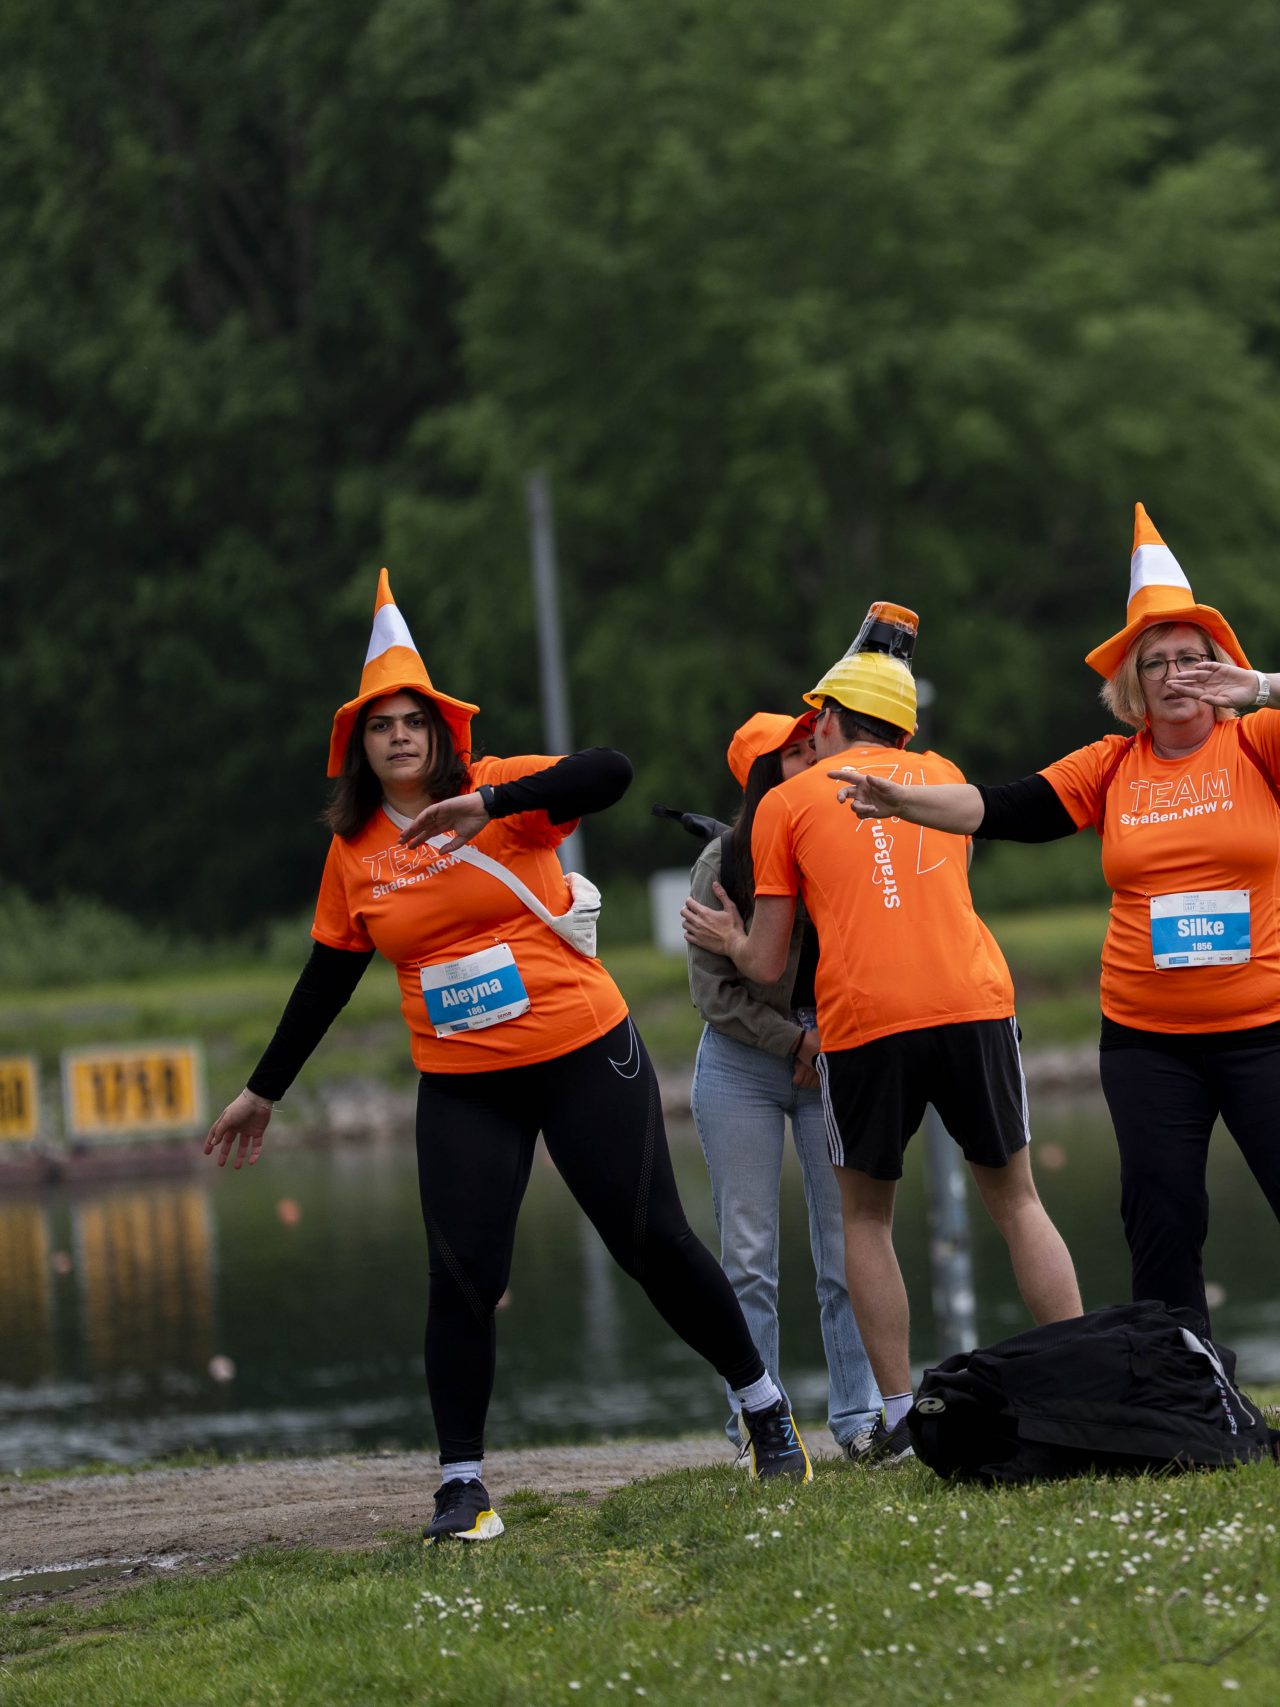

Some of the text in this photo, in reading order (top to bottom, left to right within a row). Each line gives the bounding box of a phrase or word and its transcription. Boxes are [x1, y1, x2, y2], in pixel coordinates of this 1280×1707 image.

[1130, 768, 1231, 813] TEAM
[1119, 801, 1218, 826] Straßen.NRW
[1177, 917, 1225, 937] Silke
[1191, 942, 1213, 951] 1856
[441, 978, 503, 1009] Aleyna
[466, 1004, 487, 1017] 1861
